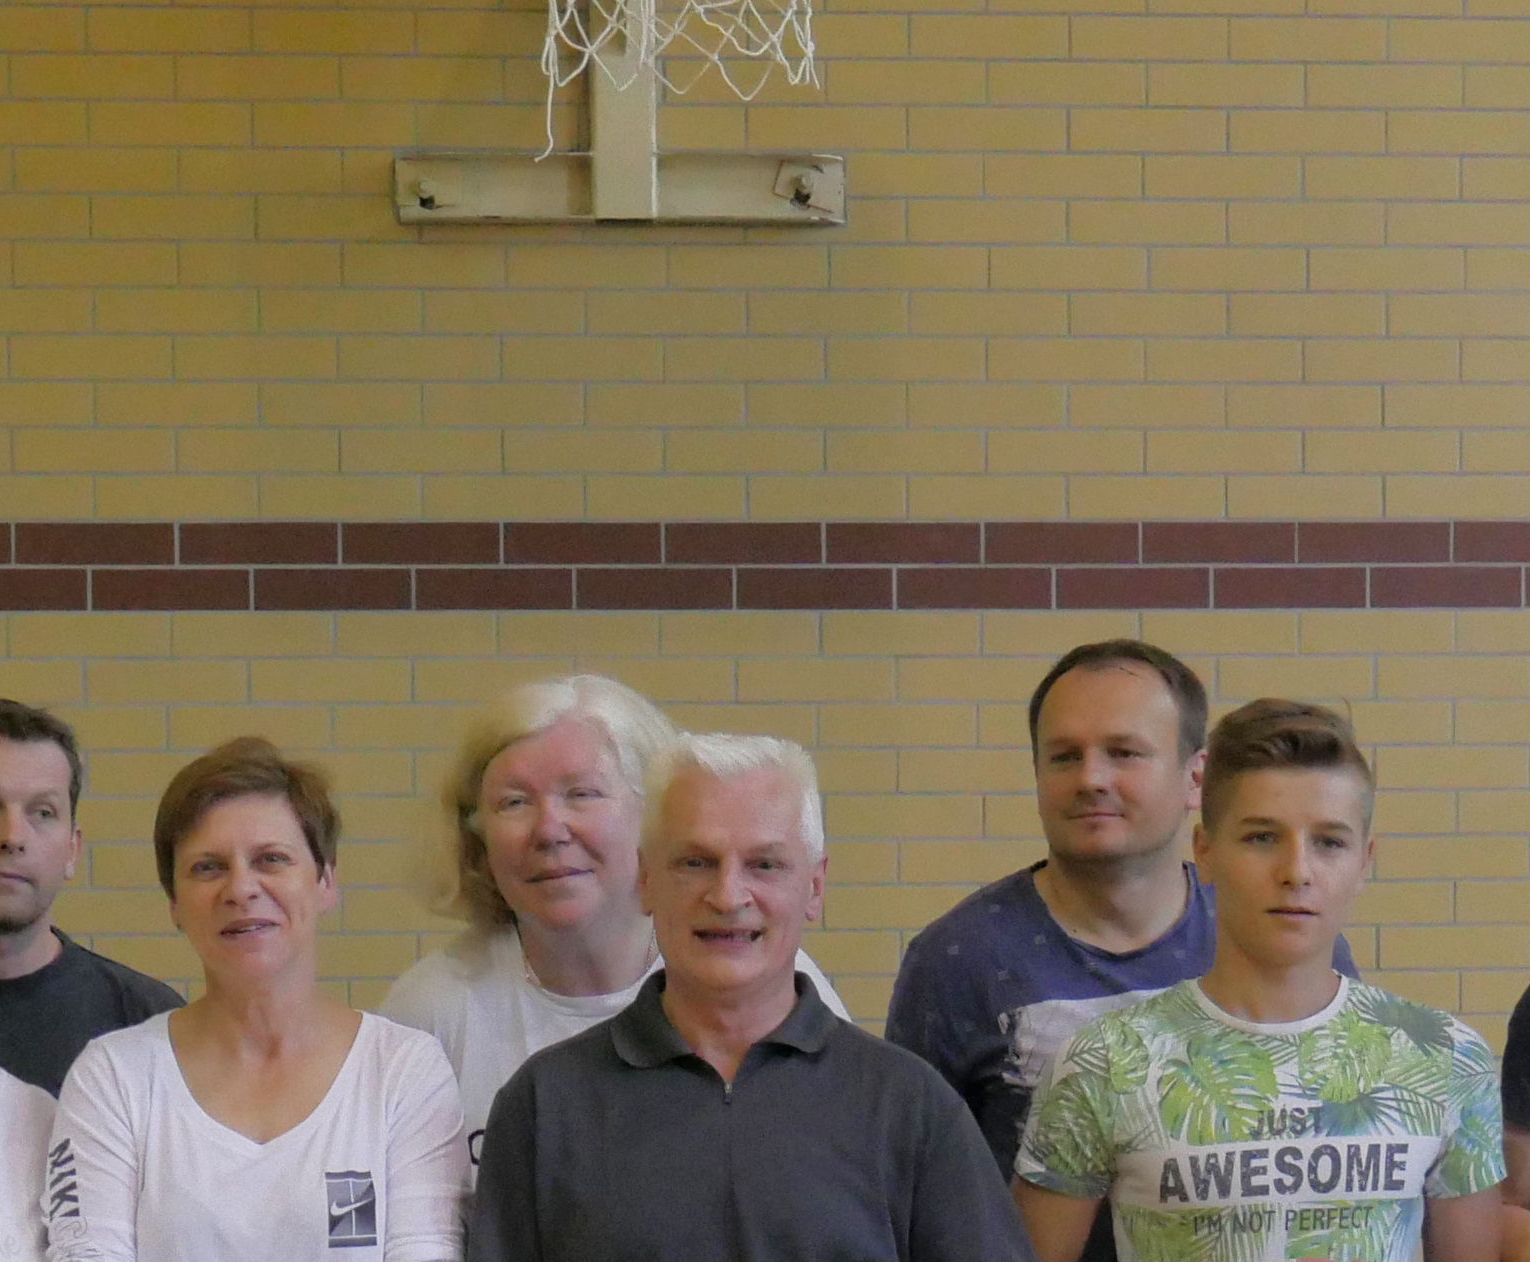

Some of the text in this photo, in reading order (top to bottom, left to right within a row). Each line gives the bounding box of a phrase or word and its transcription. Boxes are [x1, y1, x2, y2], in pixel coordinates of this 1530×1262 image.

[1249, 1106, 1326, 1136] JUST
[1159, 1143, 1409, 1203] AWESOME
[1232, 1211, 1276, 1233] NOT
[1285, 1206, 1374, 1230] PERFECT
